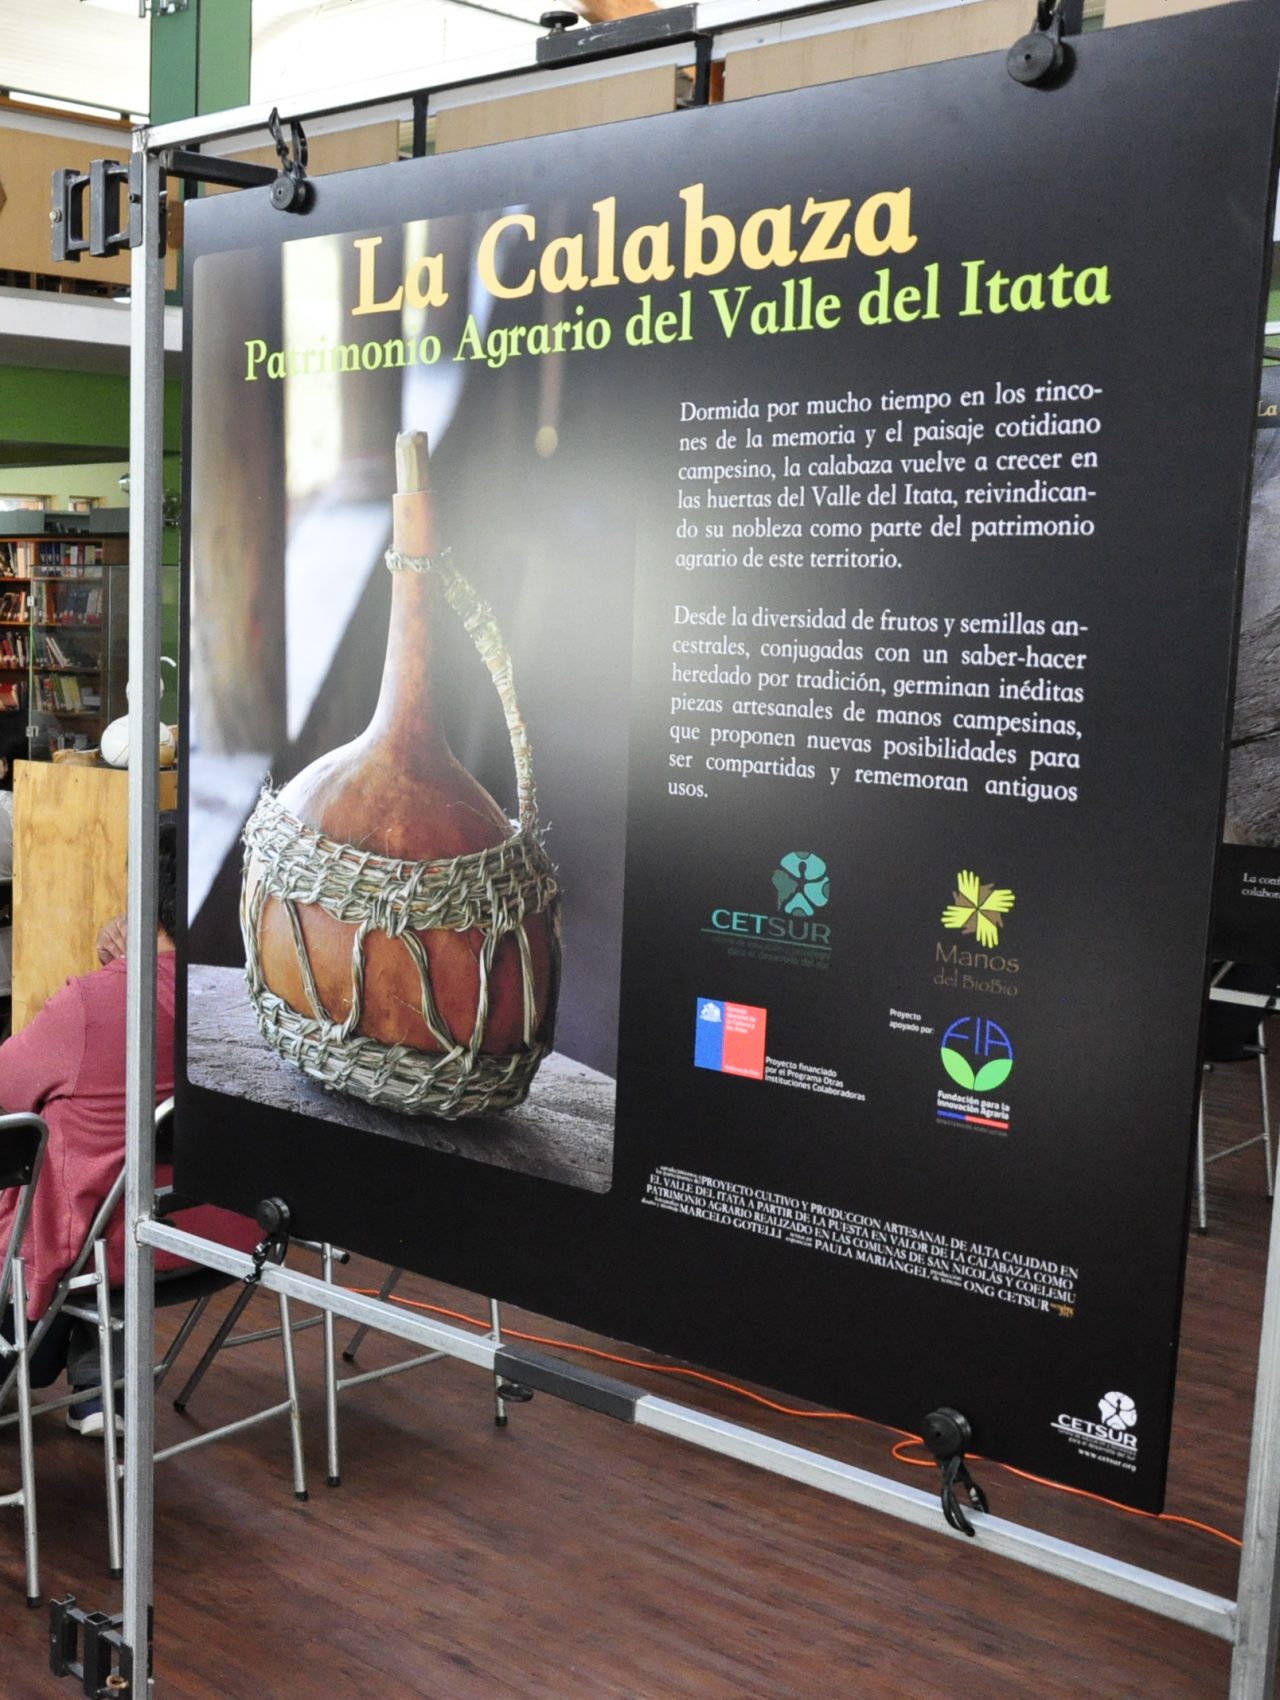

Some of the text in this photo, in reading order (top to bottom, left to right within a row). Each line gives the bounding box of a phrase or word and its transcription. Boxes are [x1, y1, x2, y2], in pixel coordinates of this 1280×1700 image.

[352, 182, 918, 316] La Calabaza
[244, 259, 1111, 382] Patrimonio Agrario del Valle del Itata
[680, 381, 1102, 421] Dormida por mucho tiempo en los rinco-
[679, 413, 1101, 450] nes de la memoria y el paisaje cotidiano
[679, 449, 1098, 482] campesino, la calabaza vuelve a crecer en
[678, 481, 1096, 509] las huertas del Valle del Itata, reivindican-
[676, 515, 1095, 541] do su nobleza como parte del patrimonio
[676, 548, 902, 570] agrario de este territorio.
[674, 605, 1088, 637] Desde la diversidad de frutos y semillas an-
[673, 637, 1087, 669] cestrales, conjugadas con un saber-hacer
[672, 664, 1084, 703] heredado por tradición, germinan inéditas
[671, 694, 1082, 739] piezas artesanales de manos campesinas,
[670, 724, 1080, 771] que proponen nuevas posibilidades para
[668, 780, 708, 798] usos.
[669, 753, 1078, 802] ser compartidas y rememoran antiguos
[712, 908, 831, 944] CETSUR
[935, 941, 1019, 973] Manos
[933, 966, 958, 988] del
[889, 1008, 921, 1021] Proyecto
[889, 1020, 919, 1032] apoyado
[941, 1016, 1013, 1060] FIA
[765, 1066, 777, 1076] por
[778, 1067, 786, 1075] el
[787, 1069, 821, 1083] Programa
[823, 1076, 844, 1088] Otras
[766, 1056, 797, 1070] Proyecto
[798, 1062, 837, 1077] financiado
[765, 1074, 865, 1101] Instituciones Colaboradoras
[937, 1090, 1010, 1112] Fundación para la
[937, 1099, 1009, 1120] Innovación Agraria
[650, 1174, 662, 1185] EL
[664, 1177, 694, 1193] VALLE
[695, 1185, 715, 1199] DEL
[717, 1191, 745, 1207] ITATA
[748, 1199, 755, 1209] A
[757, 1200, 792, 1218] PARTIR
[795, 1210, 810, 1223] DE
[813, 1215, 826, 1227] LA
[828, 1219, 869, 1239] PUESTA
[871, 1230, 887, 1242] EN
[890, 1235, 928, 1254] VALOR
[931, 1245, 948, 1258] DE
[950, 1250, 965, 1263] LA
[967, 1255, 1031, 1280] CALABAZA
[1034, 1271, 1073, 1290] COMO
[701, 1175, 753, 1197] PROYECTO
[755, 1189, 799, 1208] CULTIVO
[801, 1201, 809, 1211] Y
[811, 1203, 880, 1229] PRODUCCION
[883, 1222, 948, 1246] ARTESANAL
[950, 1237, 967, 1251] DE
[970, 1243, 1000, 1260] ALTA
[1002, 1251, 1058, 1274] CALIDAD
[1060, 1265, 1078, 1279] EN
[646, 1184, 706, 1207] PATRIMONIO
[708, 1200, 752, 1219] AGRARIO
[754, 1212, 812, 1235] REALIZADO
[815, 1228, 830, 1240] EN
[832, 1232, 851, 1245] LAS
[853, 1238, 906, 1260] COMUNAS
[909, 1251, 925, 1264] DE
[927, 1256, 949, 1271] SAN
[1005, 1276, 1014, 1287] Y
[1015, 1280, 1076, 1304] COELEMU
[680, 1203, 731, 1225] MARCELO
[733, 1217, 782, 1239] GOTELLI
[815, 1239, 853, 1258] PAULA
[964, 1280, 995, 1297] ONG
[998, 1289, 1050, 1312] CETSUR
[1057, 1413, 1137, 1448] CETSUR
